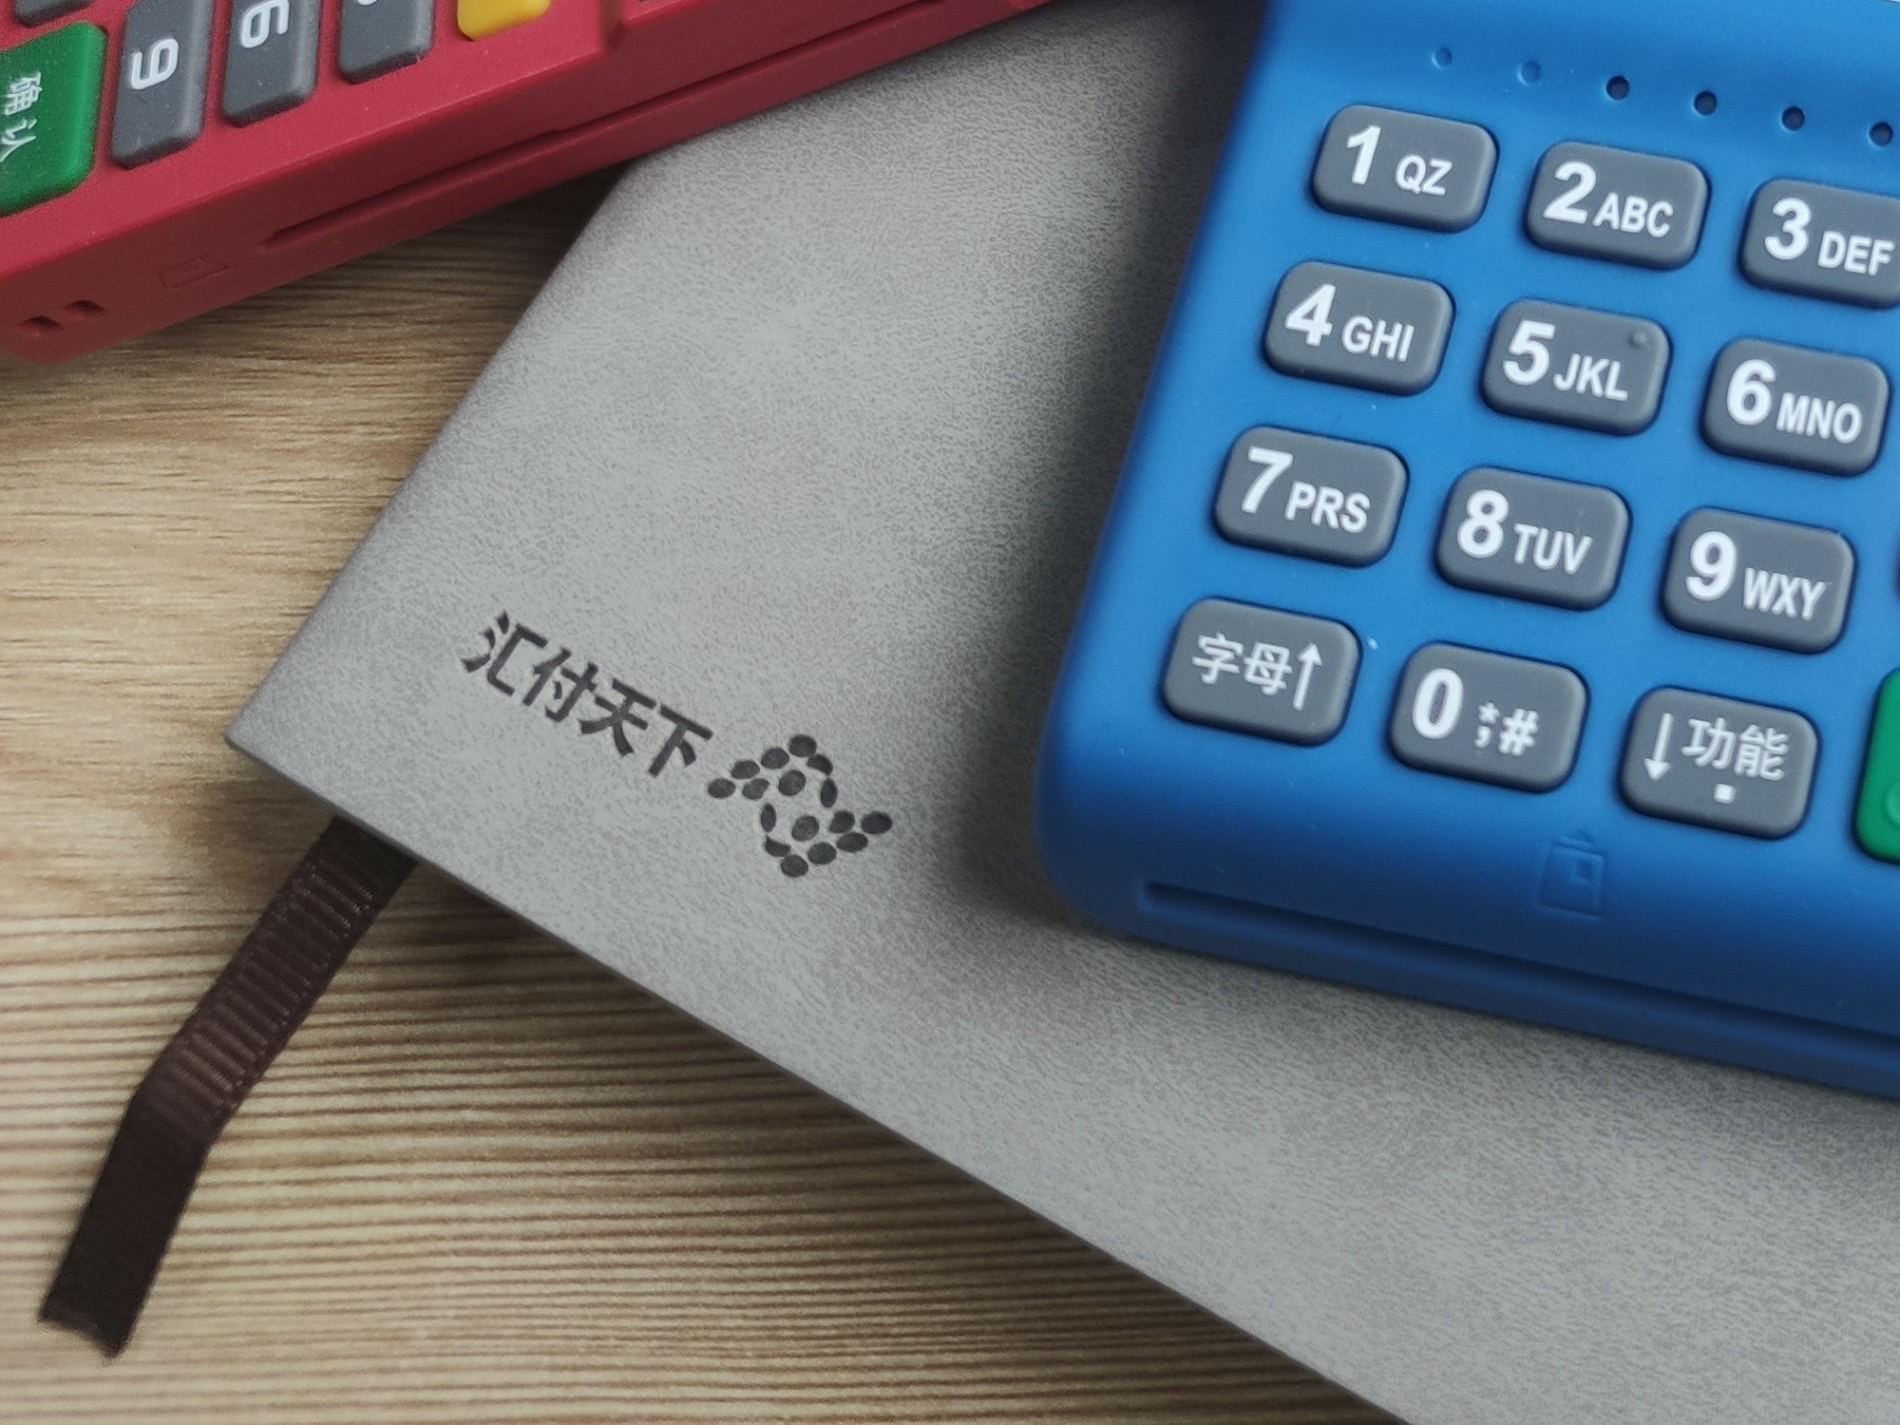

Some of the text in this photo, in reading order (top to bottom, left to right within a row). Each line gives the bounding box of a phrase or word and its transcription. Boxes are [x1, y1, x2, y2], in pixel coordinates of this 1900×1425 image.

[129, 37, 179, 90] 9
[0, 71, 43, 162] 确认
[1346, 125, 1453, 196] 1 QZ
[1543, 161, 1674, 238] 2 ABC
[1764, 197, 1896, 276] 3 DEF
[1285, 283, 1415, 363] 4 GHI
[1502, 319, 1629, 402] 5 JKL
[1726, 359, 1863, 444] 6 MNO
[1240, 446, 1372, 533] 7 PRS
[1457, 490, 1593, 574] 8 TUV
[1685, 531, 1827, 621] 9 WXY
[461, 611, 713, 778] 汇付天下
[1192, 632, 1294, 696] 字母
[1413, 668, 1463, 739] 0
[1681, 717, 1789, 782] 功能
